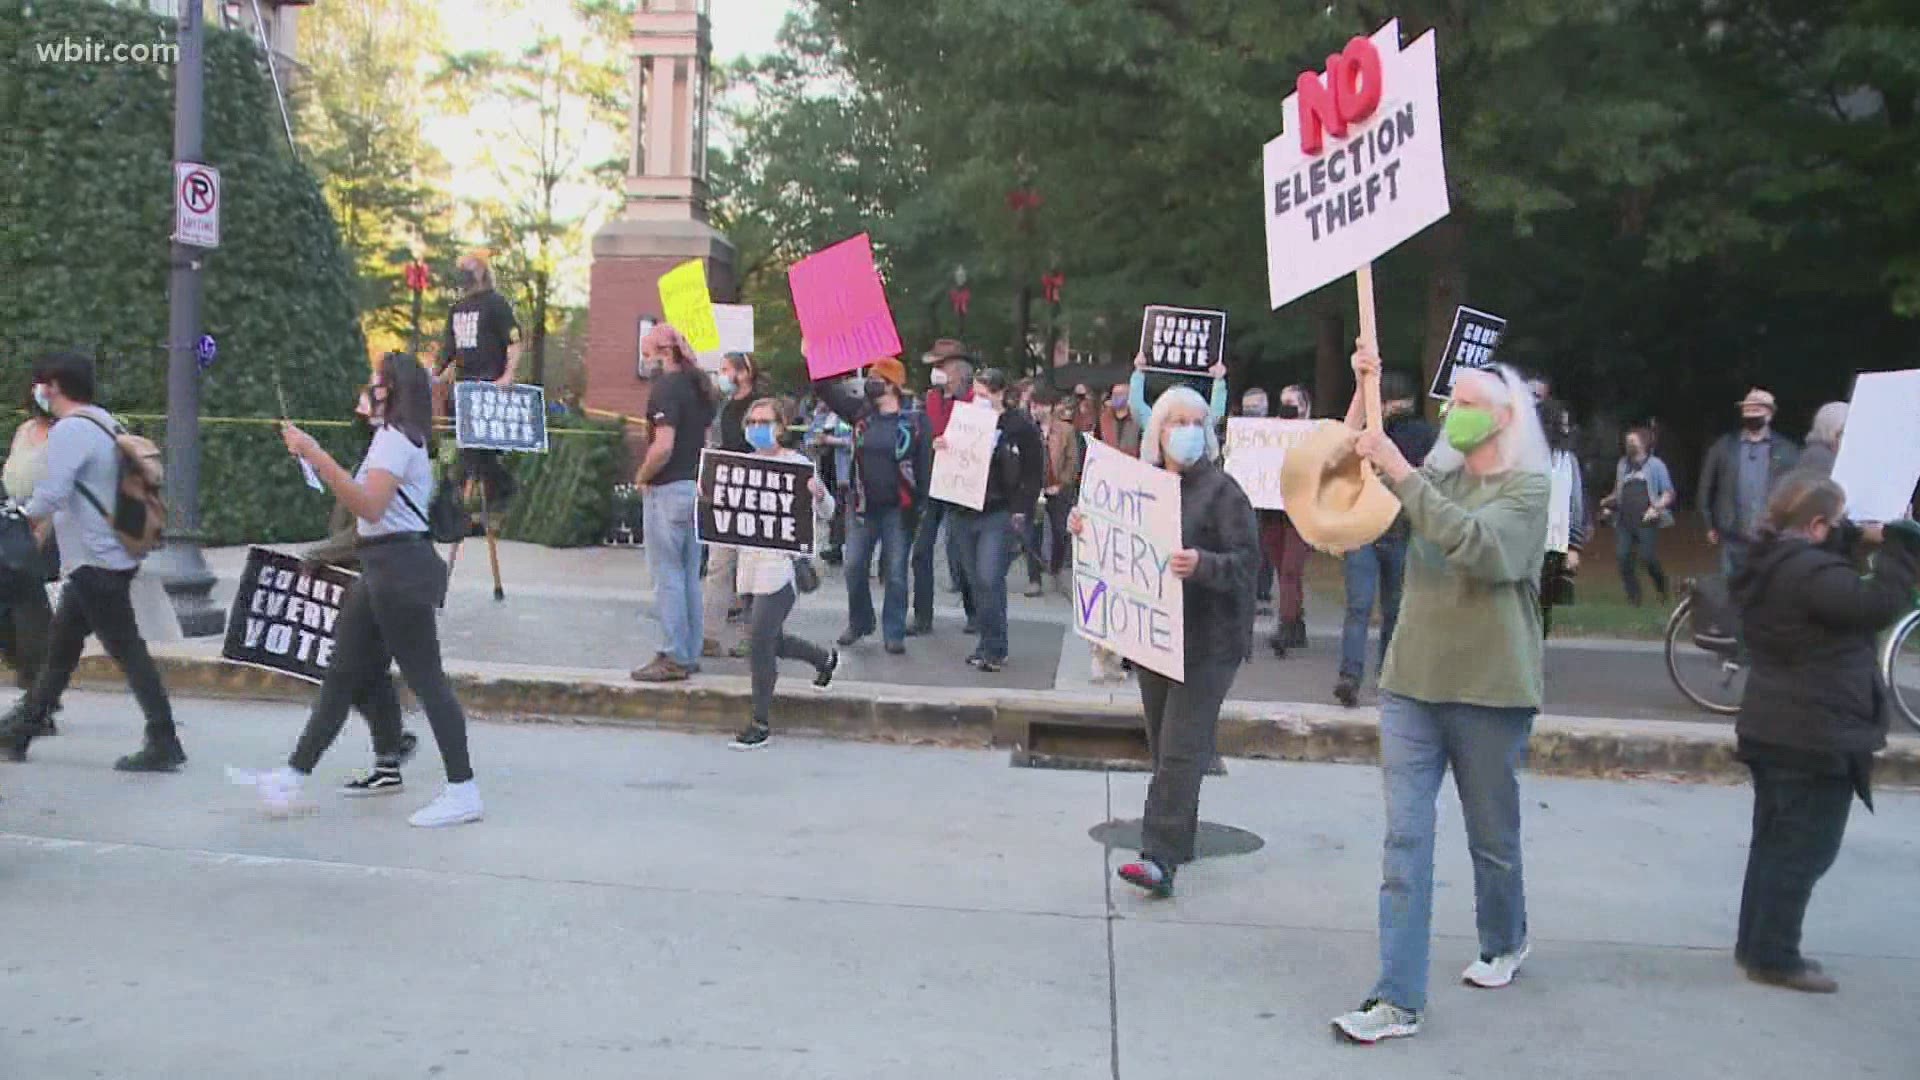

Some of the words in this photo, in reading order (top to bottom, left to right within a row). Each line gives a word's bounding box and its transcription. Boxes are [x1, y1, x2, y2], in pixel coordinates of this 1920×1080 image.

[1296, 35, 1382, 156] NO
[1274, 101, 1415, 216] ELECTION
[1305, 158, 1401, 241] THEFT
[1153, 328, 1209, 347] EVERY
[1155, 314, 1211, 333] COUNT
[1152, 344, 1209, 366] VOTE
[713, 483, 795, 514] EVERY
[715, 463, 796, 491] COUNT
[1081, 456, 1156, 526] Count
[713, 509, 796, 542] VOTE
[1076, 512, 1171, 599] EVERY
[259, 565, 345, 606] COUNT
[251, 589, 340, 633] EVERY
[1077, 580, 1173, 651] VOTE
[244, 618, 336, 668] VOTE
